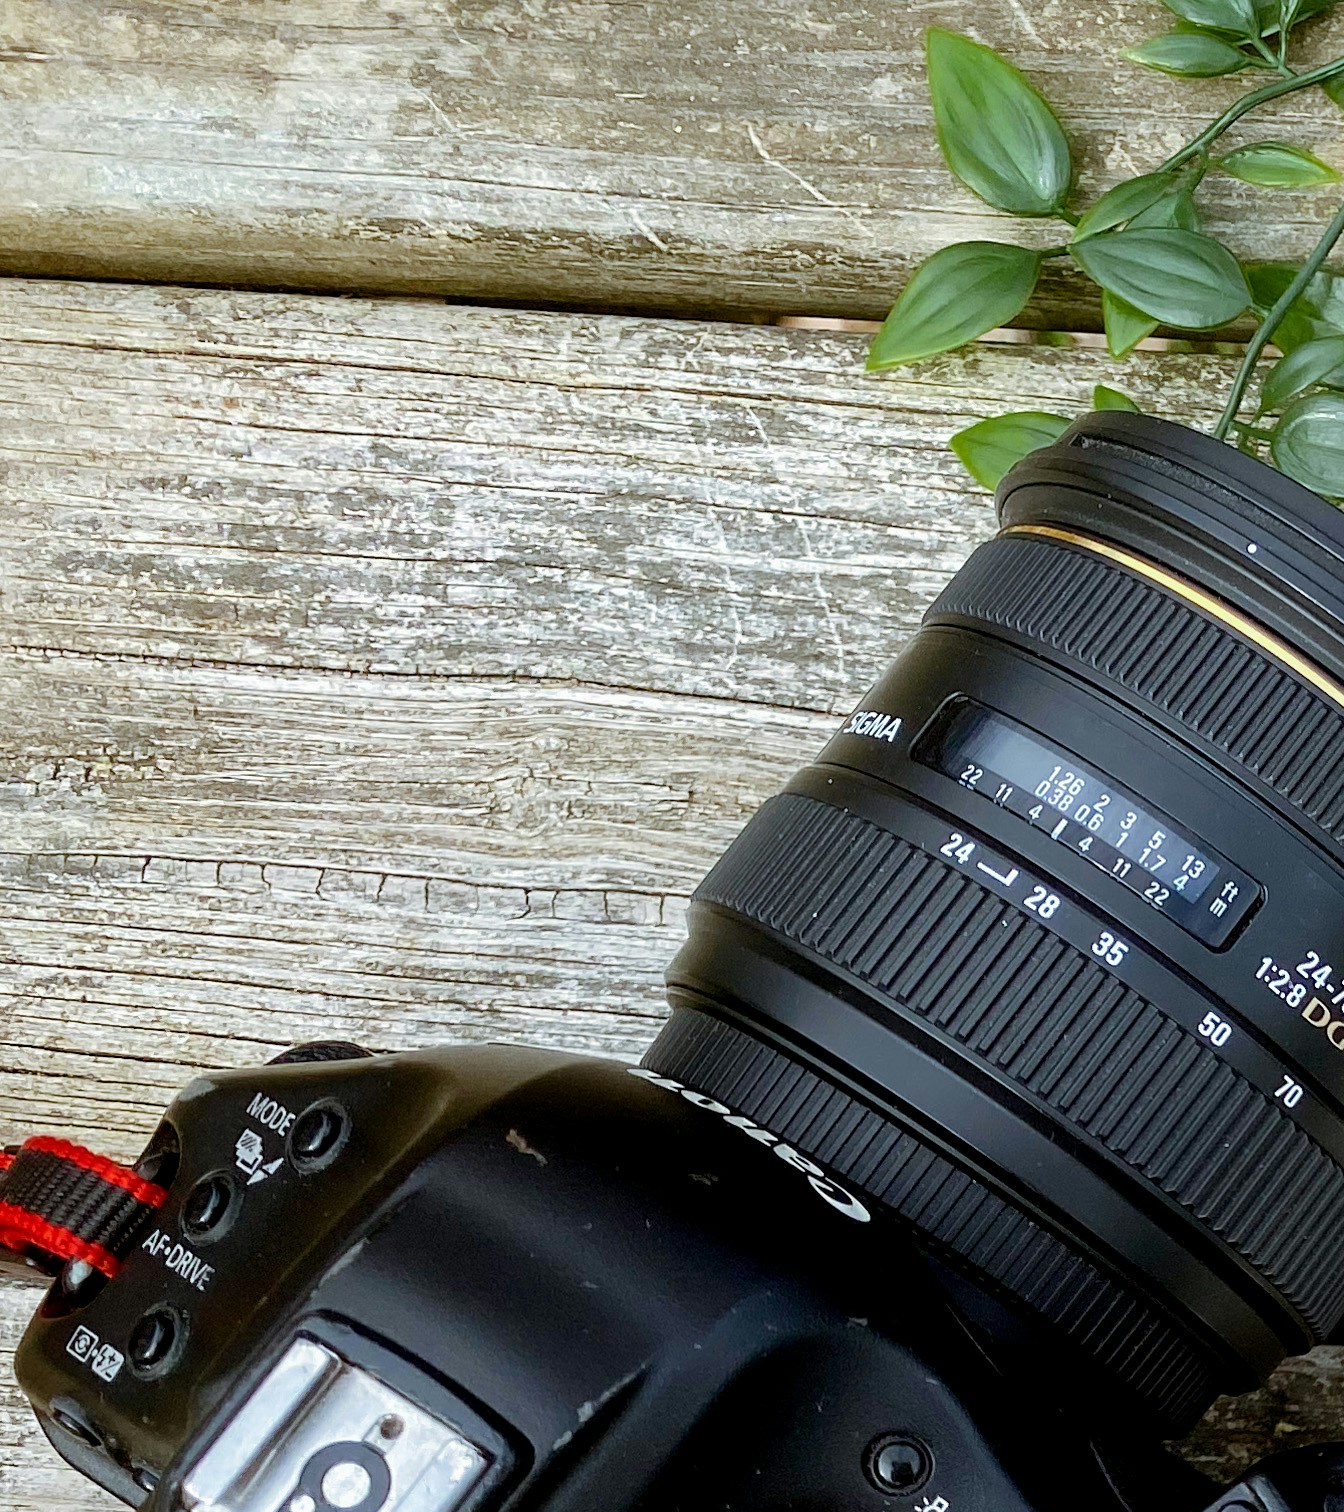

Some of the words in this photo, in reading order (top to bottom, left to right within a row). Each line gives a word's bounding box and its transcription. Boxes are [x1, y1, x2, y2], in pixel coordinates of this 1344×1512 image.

[843, 710, 903, 743] SIGMA
[960, 764, 984, 785] 22
[995, 783, 1013, 802] 11
[1028, 805, 1043, 820] 4
[1078, 837, 1094, 852] 4
[1112, 858, 1132, 878] 11
[1144, 882, 1170, 906] 22
[1034, 780, 1074, 811] 0.38
[1074, 804, 1105, 831] 0.6
[1115, 832, 1129, 848] 1
[1139, 848, 1167, 872] 1.7
[1173, 875, 1189, 892] 4
[1209, 899, 1228, 918] m
[1048, 765, 1085, 796] 1.26
[1093, 795, 1111, 813] 2
[1120, 812, 1137, 830] 3
[1148, 830, 1166, 849] 5
[1181, 855, 1206, 879] 13
[1221, 881, 1239, 903] ft
[940, 832, 976, 865] 24
[1023, 885, 1061, 919] 28
[1091, 931, 1129, 967] 35
[1197, 1011, 1232, 1048] 50
[1274, 1074, 1303, 1108] 70
[1255, 957, 1307, 1008] 1:2.8
[246, 1092, 296, 1137] MODE
[626, 1068, 871, 1222] Canon
